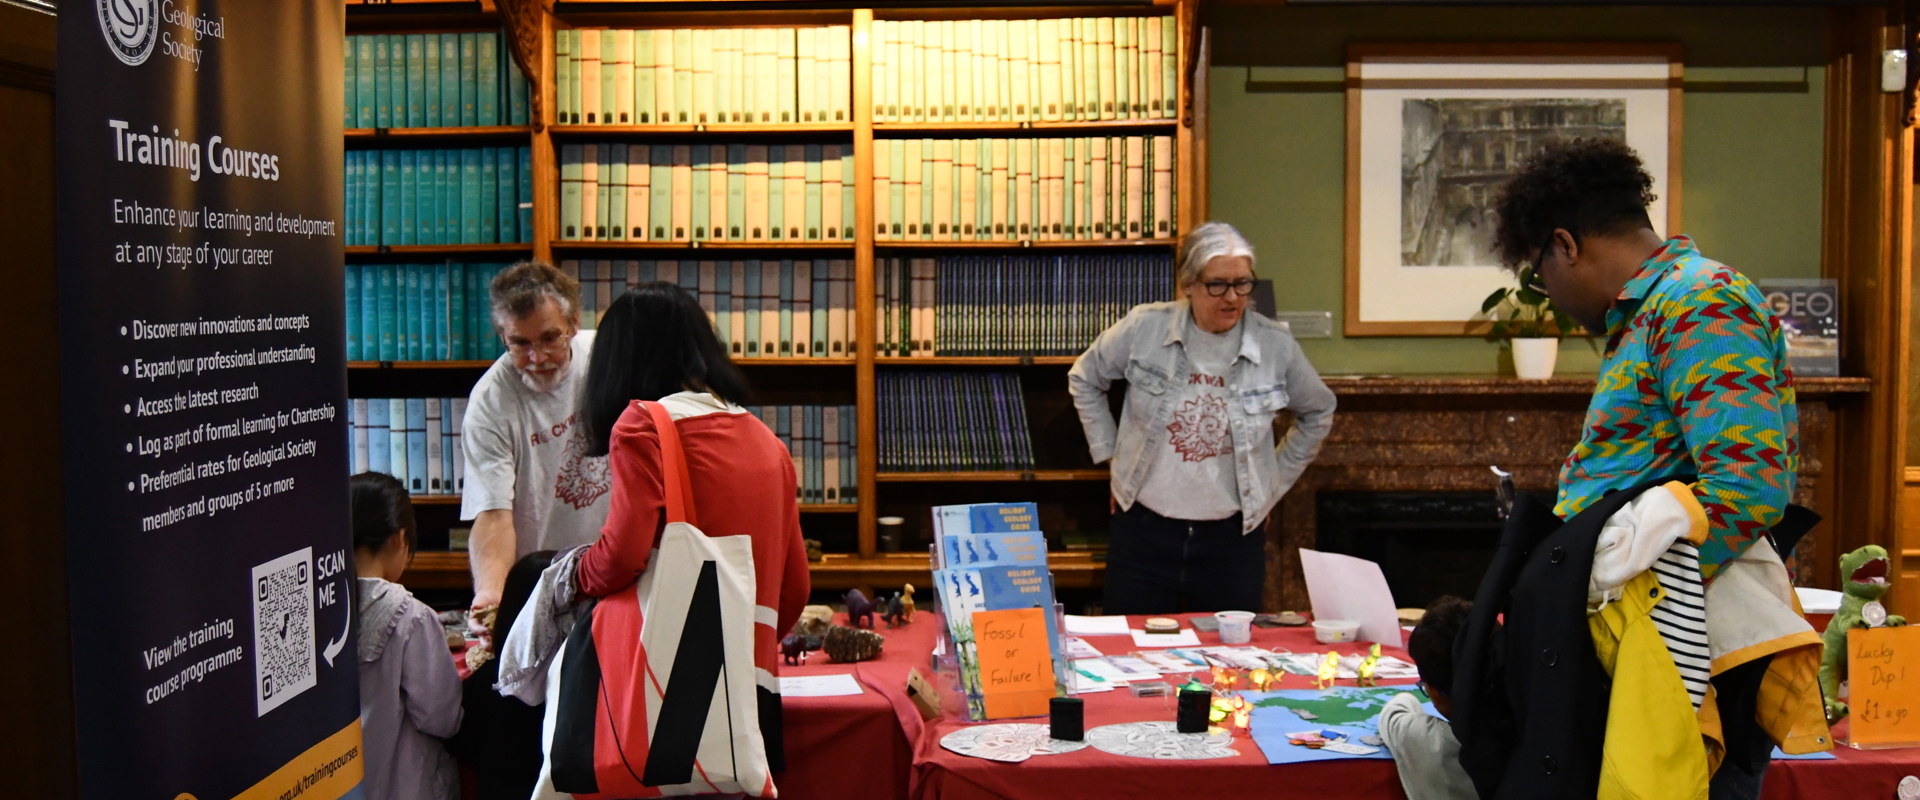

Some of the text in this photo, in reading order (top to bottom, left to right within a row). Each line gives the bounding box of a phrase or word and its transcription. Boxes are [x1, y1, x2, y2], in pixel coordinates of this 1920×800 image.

[162, 0, 225, 40] Geological
[162, 33, 202, 72] Society
[109, 119, 280, 182] Training Courses
[114, 198, 336, 239] Enhance your learning and development
[116, 242, 274, 270] at any stage of your career
[1765, 291, 1834, 317] GEO
[133, 314, 310, 340] Discover new innovations and concepts
[135, 344, 316, 382] Expand your professional understanding
[136, 382, 259, 417] Access the latest research
[138, 403, 336, 458] Log as part of formal learning for Chartership
[140, 438, 316, 494] Preferential rates for Geological Society
[142, 476, 294, 532] members and groups of 5 or more
[318, 549, 346, 580] SCAN
[1007, 569, 1036, 578] HOLIDAY
[318, 582, 336, 609] ME
[1012, 577, 1042, 586] GEOLOGY
[1020, 586, 1041, 594] GUIDE
[143, 618, 234, 671] View the training
[984, 620, 1025, 642] Fossil
[1005, 648, 1019, 658] or
[1856, 642, 1894, 664] Lucky
[146, 646, 243, 705] course programme
[1892, 708, 1908, 726] go
